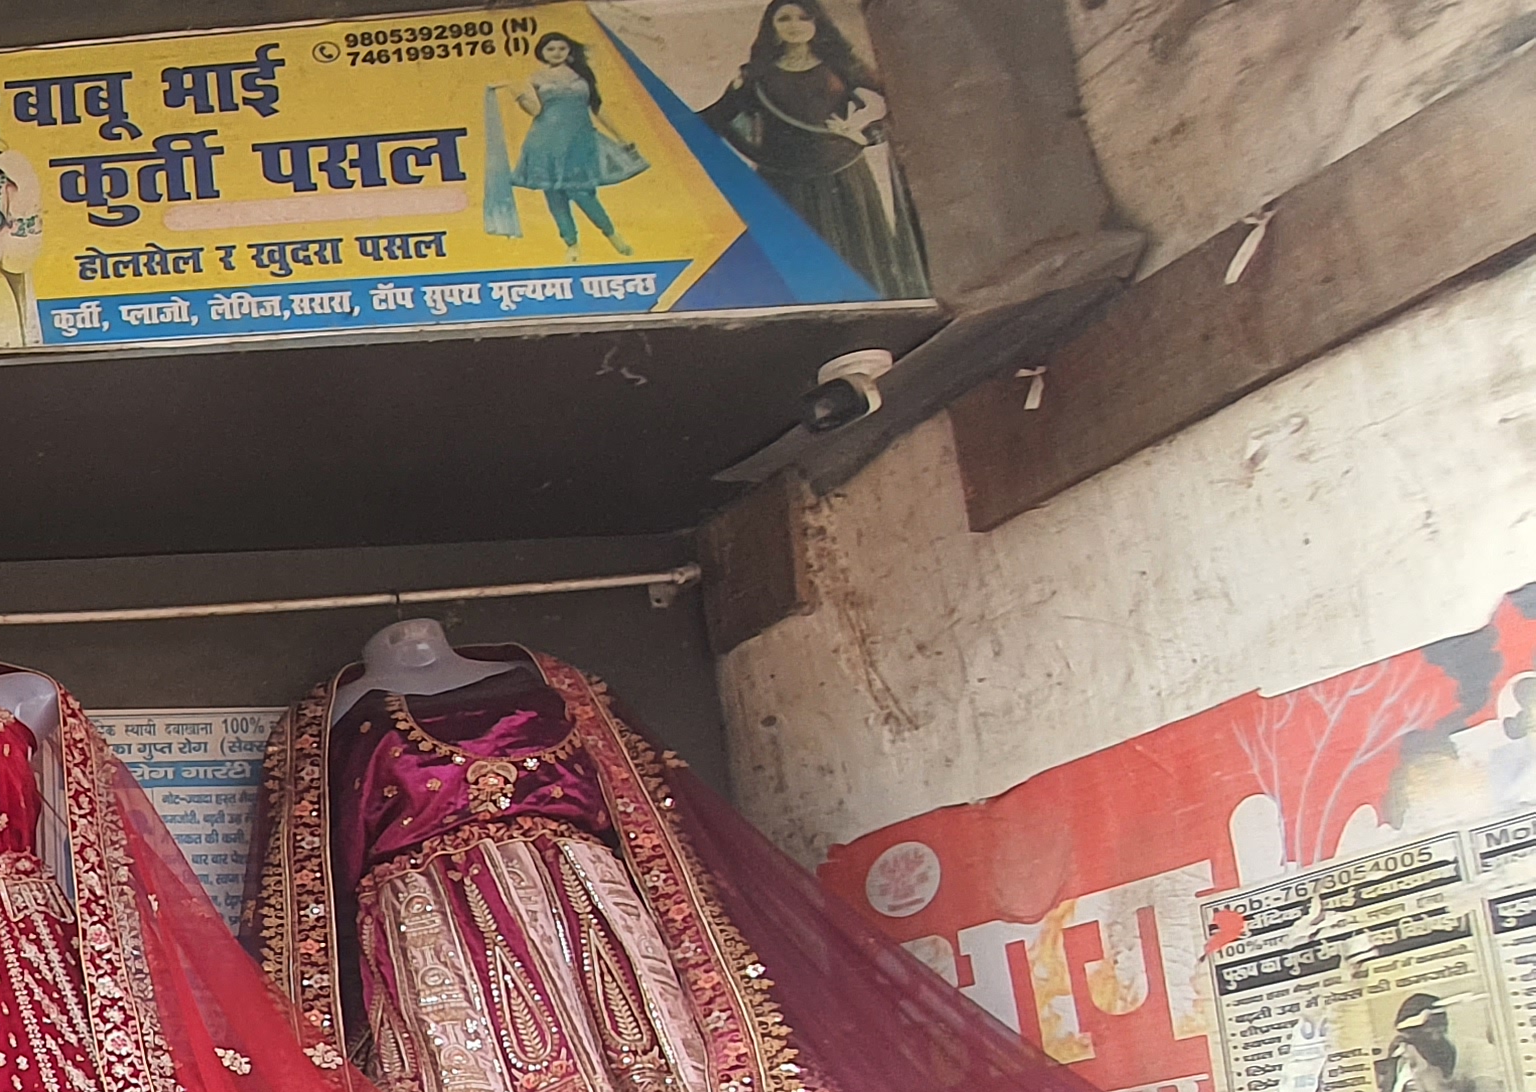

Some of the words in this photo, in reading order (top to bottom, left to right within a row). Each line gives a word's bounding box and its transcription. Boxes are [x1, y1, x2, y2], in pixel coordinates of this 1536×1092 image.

[344, 20, 494, 49] 9805392980
[502, 16, 538, 37] (N)
[346, 39, 496, 67] 7461993176
[504, 36, 531, 57] (I)
[4, 71, 143, 140] बाबू
[160, 42, 285, 118] भाई
[48, 129, 224, 227] कुर्ती
[251, 127, 468, 194] पसल
[75, 243, 205, 281] होलसेल
[215, 245, 237, 271] र
[246, 237, 344, 278] खुदरा
[354, 230, 448, 262] पसल
[50, 301, 110, 336] कुर्ती,
[118, 296, 199, 327] प्लाजो,
[369, 282, 415, 311] टॉप
[488, 277, 574, 311] मूल्यमा
[580, 273, 657, 300] पाइन्छ
[221, 716, 265, 735] 100%
[137, 741, 173, 760] गुप्त
[177, 737, 209, 755] रोग
[180, 760, 252, 780] गारंटी
